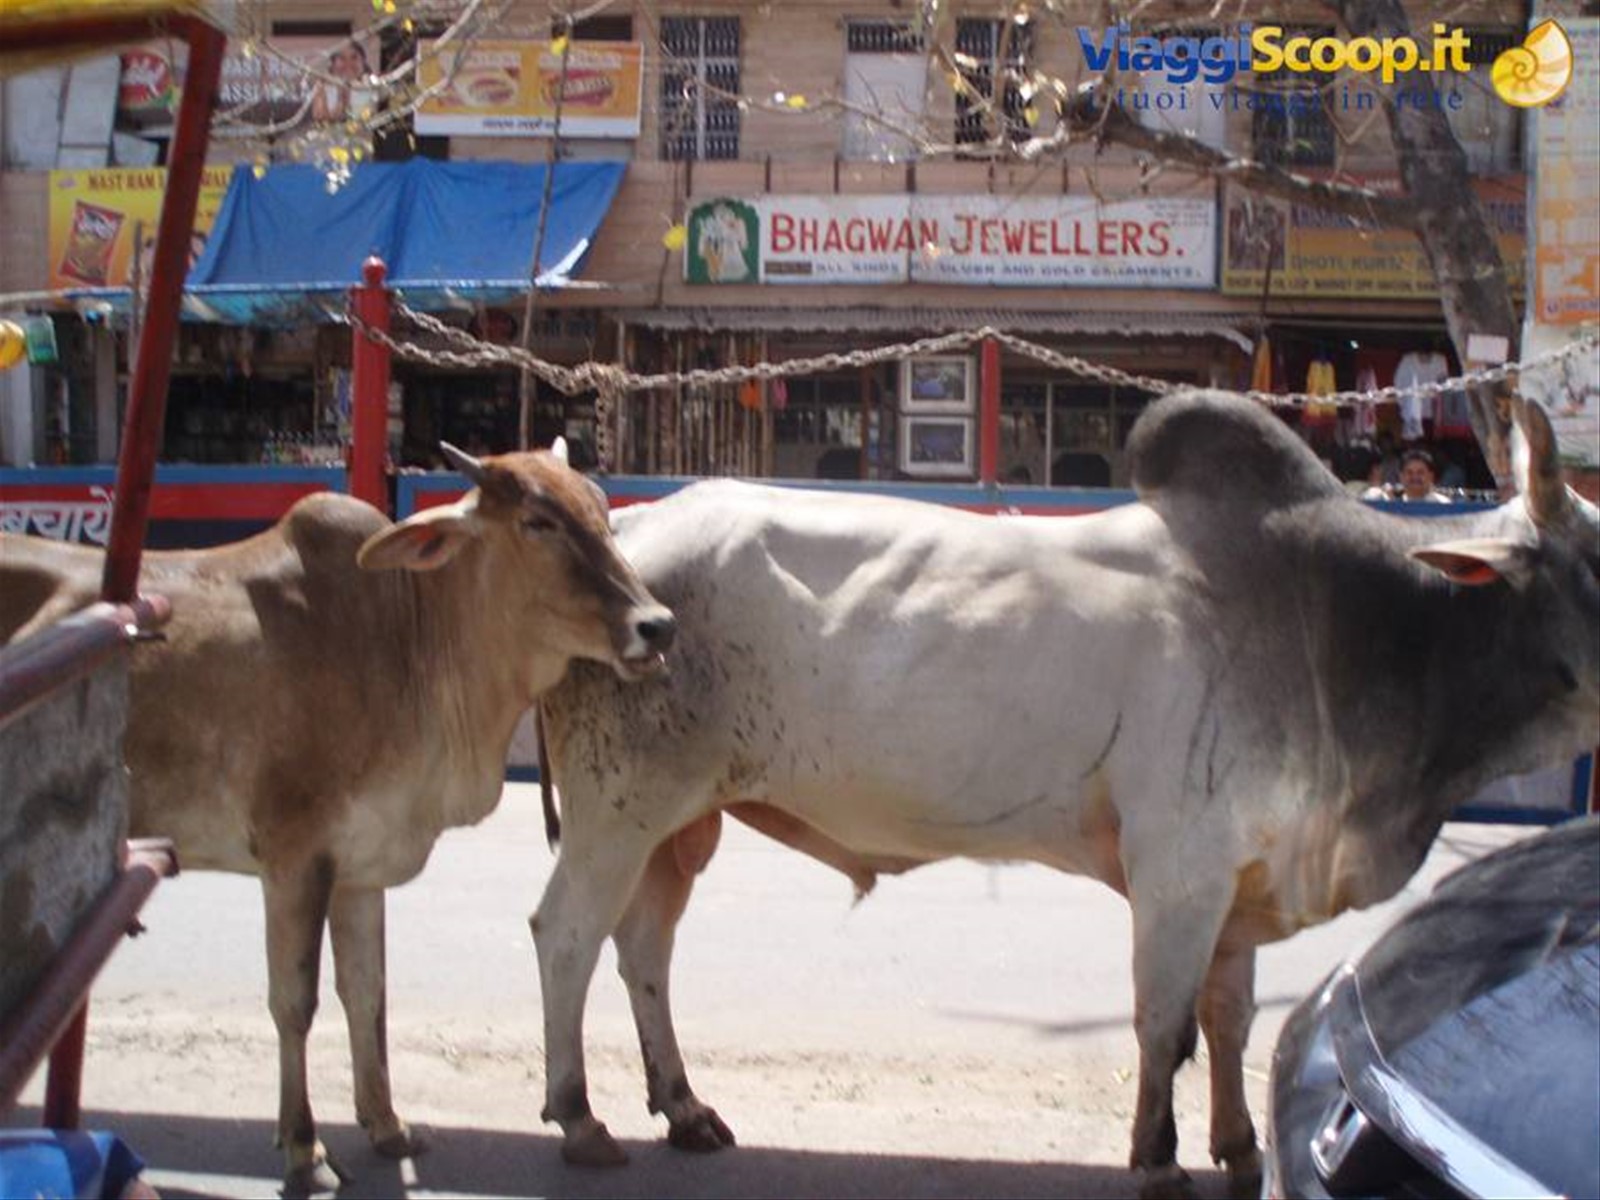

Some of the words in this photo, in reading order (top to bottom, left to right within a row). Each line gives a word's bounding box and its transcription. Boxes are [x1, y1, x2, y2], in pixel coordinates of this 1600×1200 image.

[770, 213, 938, 253] BHAGWAN
[949, 214, 1185, 257] JEWELLERS.
[1002, 267, 1035, 276] AND
